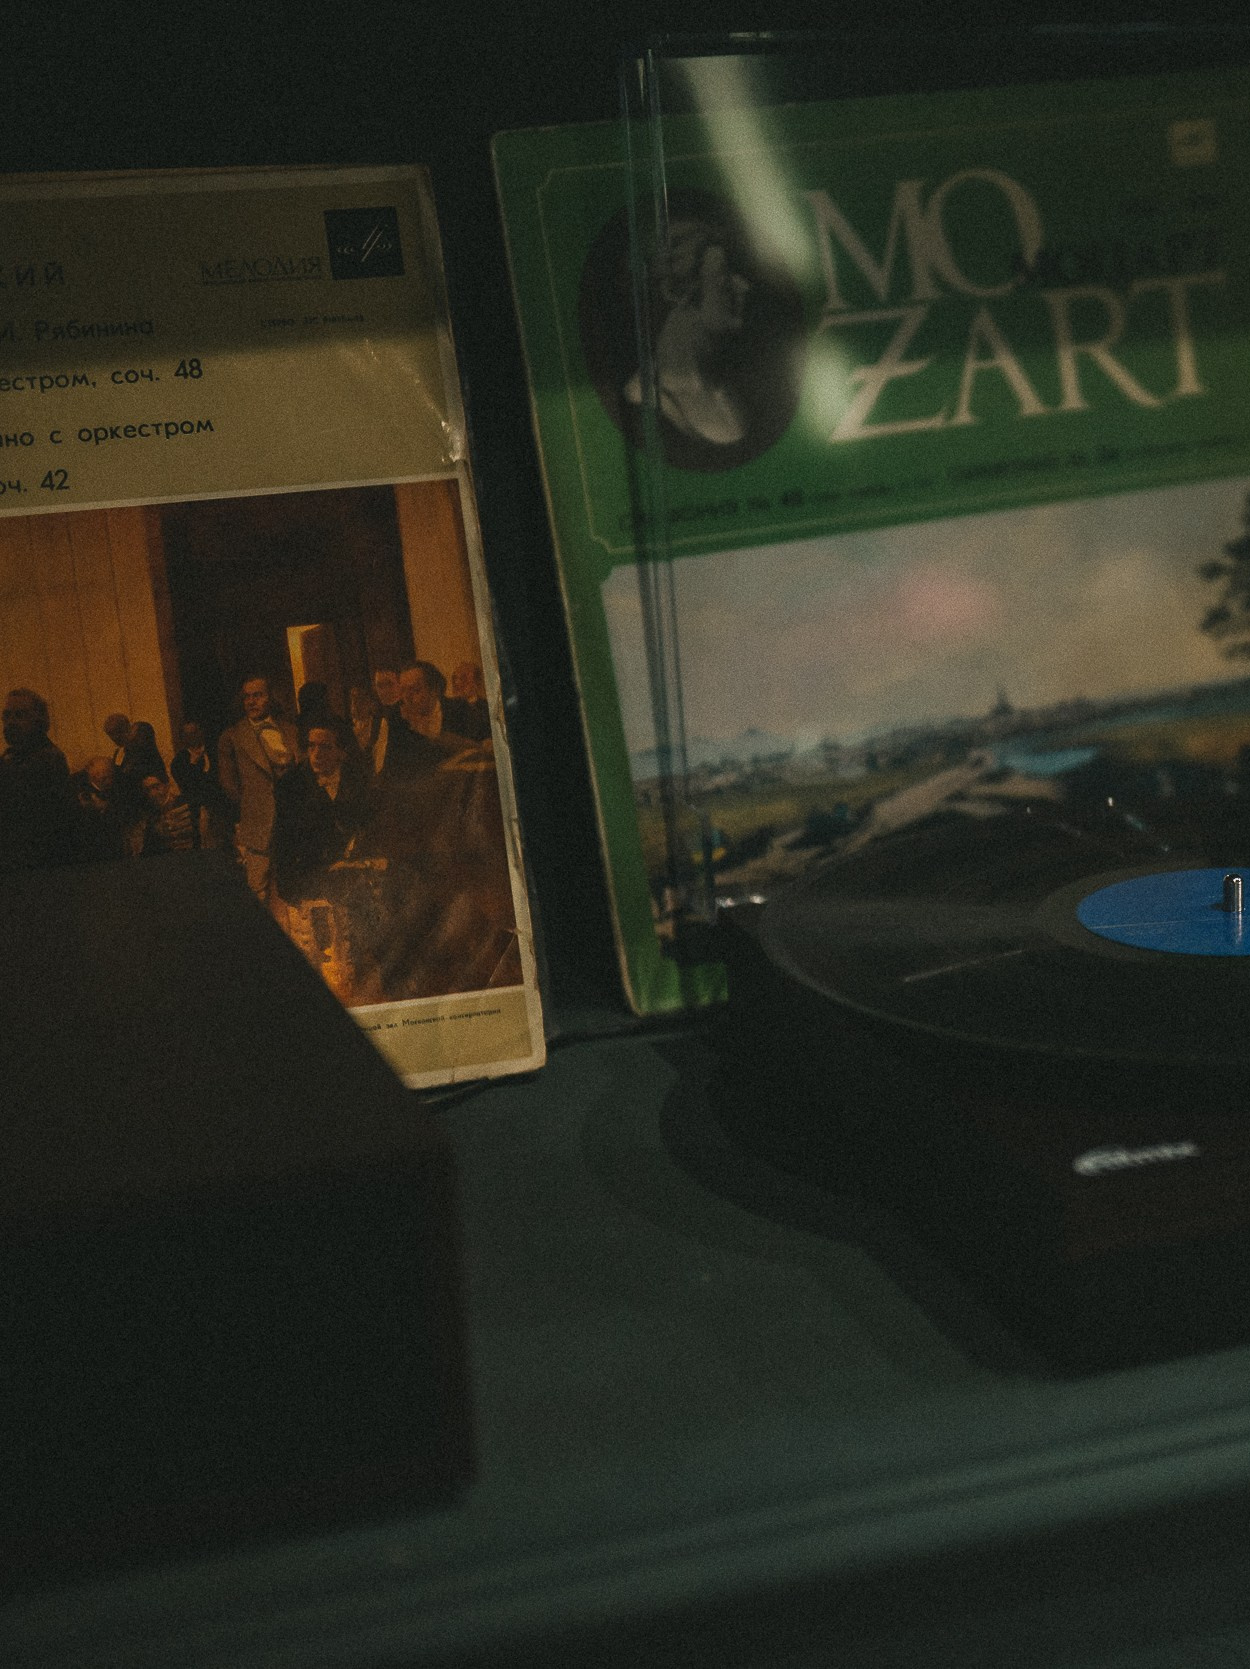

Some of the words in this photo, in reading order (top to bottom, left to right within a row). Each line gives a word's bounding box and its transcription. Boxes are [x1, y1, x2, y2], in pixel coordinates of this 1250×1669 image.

[0, 260, 66, 288] ИЙ
[34, 319, 154, 342] Рябинина
[110, 368, 160, 385] соч.
[174, 358, 204, 379] 48
[0, 431, 35, 448] но
[49, 430, 63, 444] с
[77, 419, 215, 446] оркестром
[40, 468, 70, 491] 42
